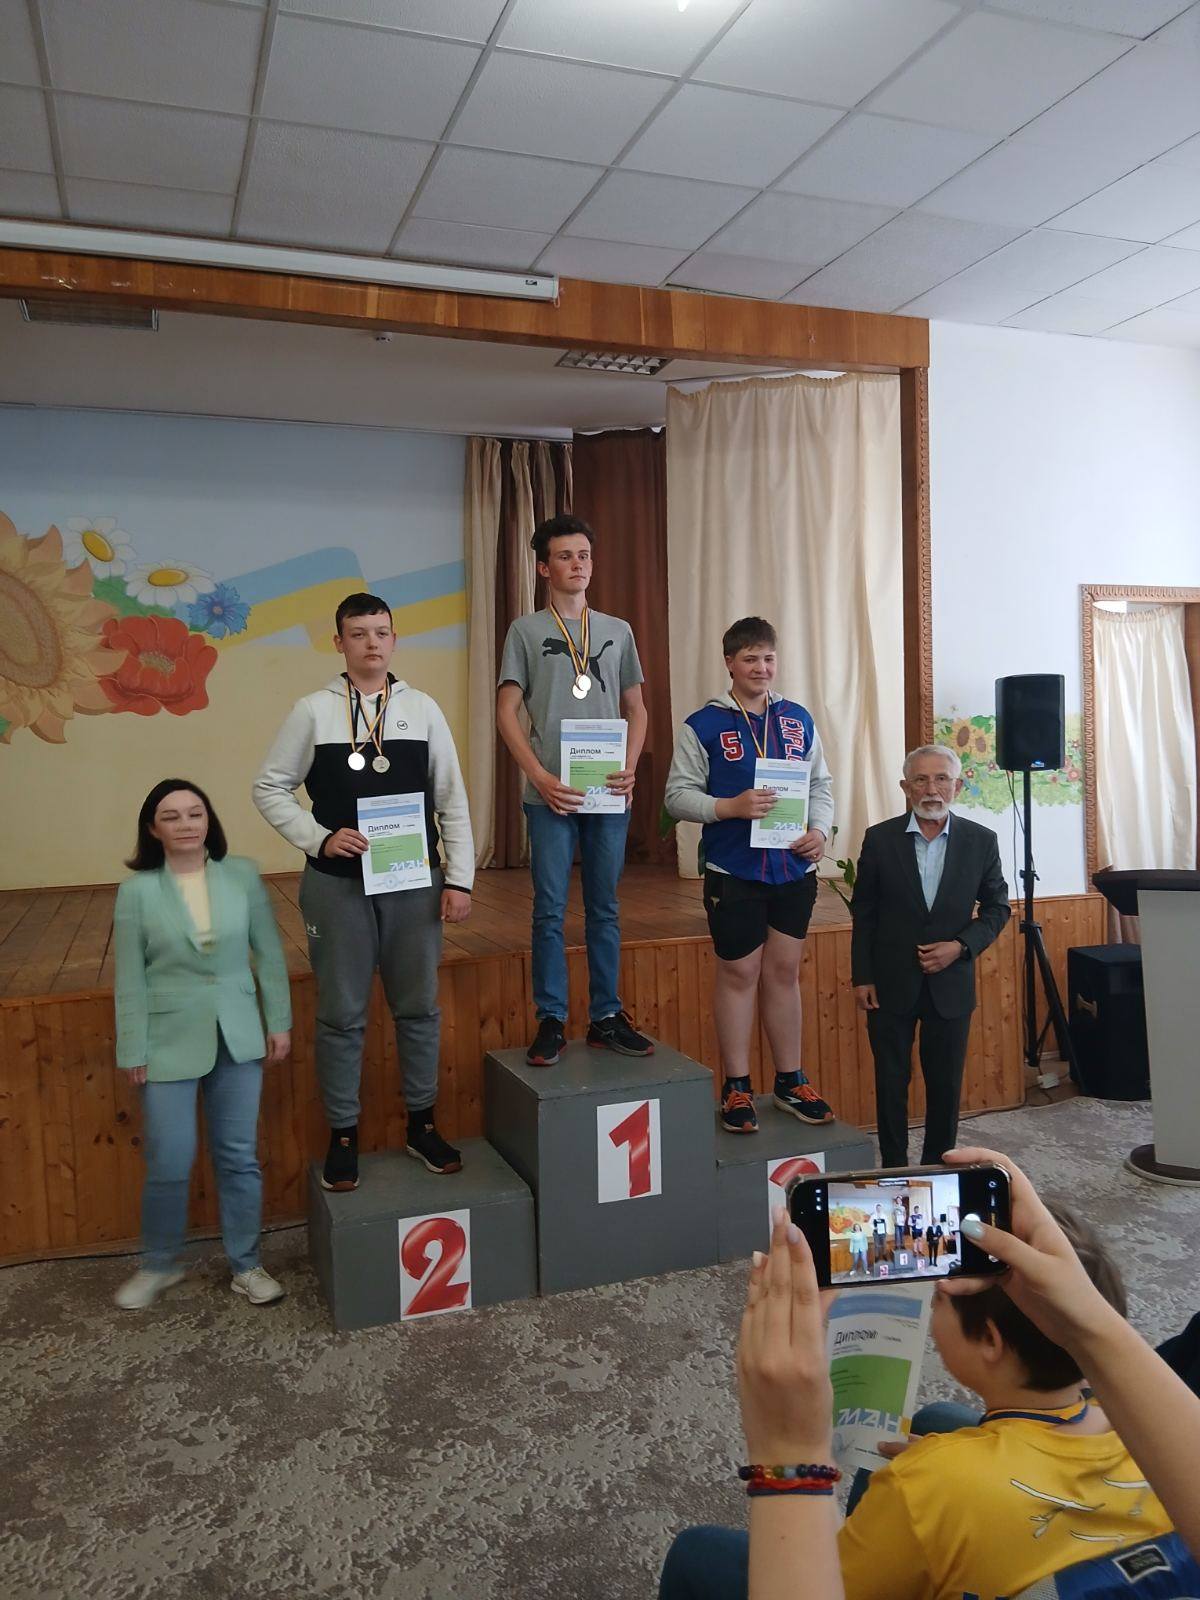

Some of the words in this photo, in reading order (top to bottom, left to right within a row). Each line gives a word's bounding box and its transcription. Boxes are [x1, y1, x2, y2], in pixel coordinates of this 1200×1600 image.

[569, 747, 602, 755] Диплом
[719, 731, 745, 762] 5
[367, 823, 401, 833] Диплом
[608, 1100, 651, 1197] 1
[401, 1217, 471, 1316] 2
[833, 1329, 878, 1345] Диплом
